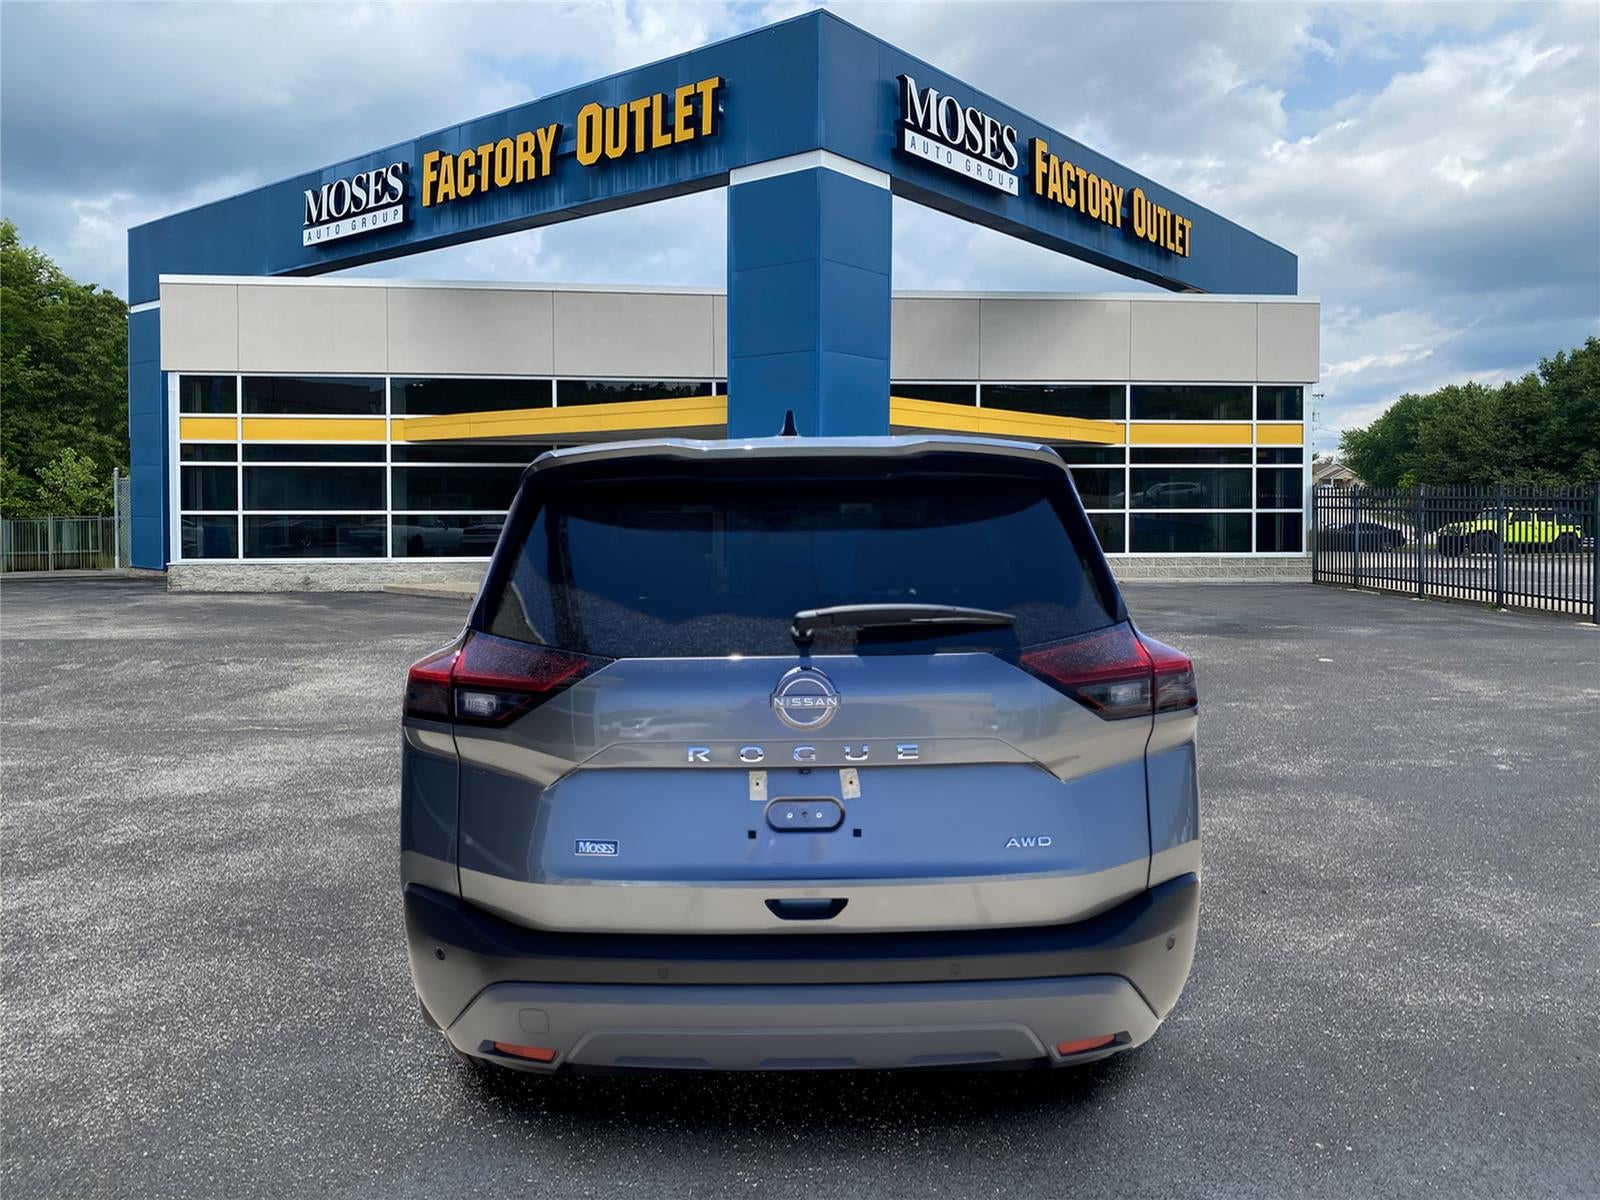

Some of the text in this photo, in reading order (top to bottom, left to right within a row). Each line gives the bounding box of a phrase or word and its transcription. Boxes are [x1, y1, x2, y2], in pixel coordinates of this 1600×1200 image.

[422, 76, 721, 207] FACTORY OUTLET
[903, 74, 1018, 171] MOSES
[909, 135, 1015, 189] AUTO GROUP
[303, 161, 404, 226] MOSES
[1034, 137, 1192, 257] FACTORY OUTLET
[306, 208, 400, 242] AUTO GROUP
[773, 696, 838, 707] NISSAN
[687, 744, 919, 763] ROGUE
[1005, 836, 1052, 848] AWD
